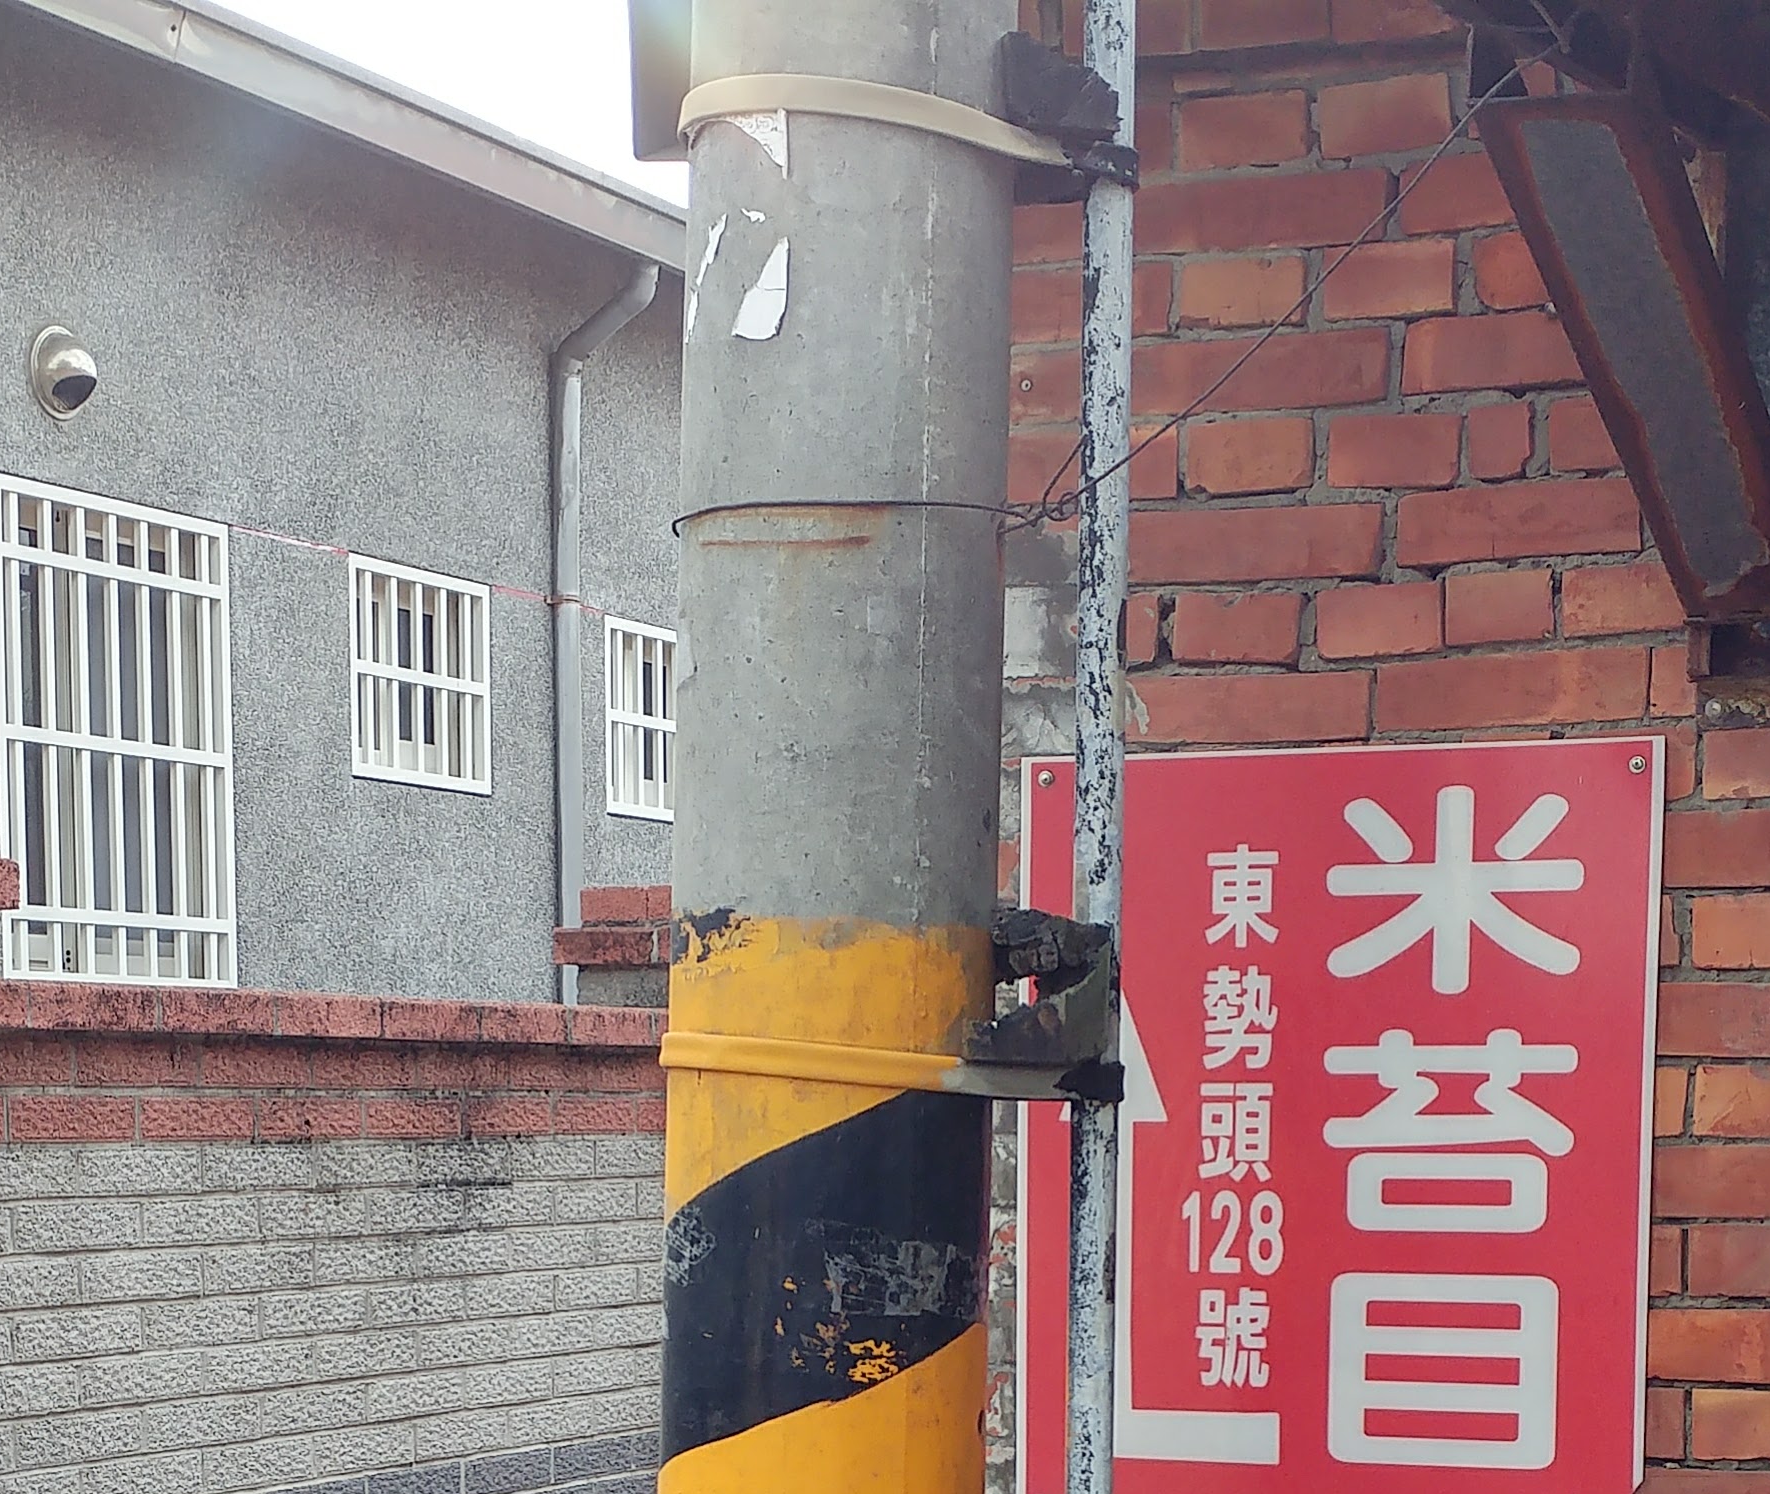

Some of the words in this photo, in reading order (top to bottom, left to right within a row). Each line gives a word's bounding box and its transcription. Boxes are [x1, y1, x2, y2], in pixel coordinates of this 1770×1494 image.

[1182, 843, 1285, 1388] 東勢頭128號
[1323, 785, 1585, 1469] 米苔目
